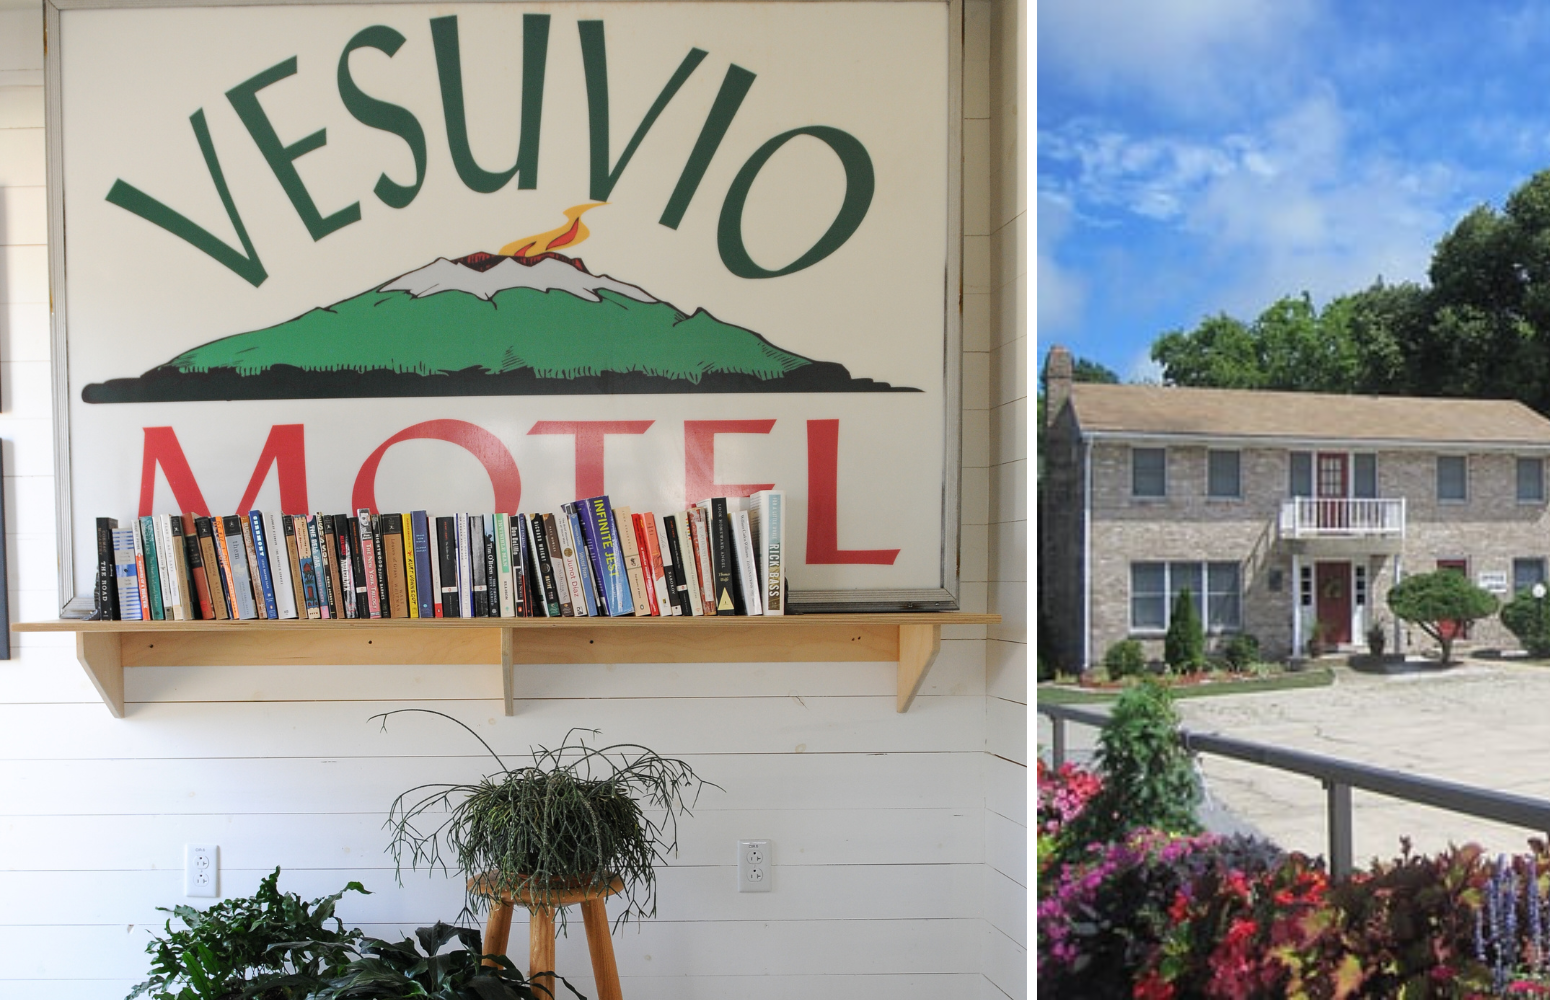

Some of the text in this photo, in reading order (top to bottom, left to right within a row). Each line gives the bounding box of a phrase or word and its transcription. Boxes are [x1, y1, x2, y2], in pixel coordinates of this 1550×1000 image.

[105, 13, 875, 288] VESUVIO
[138, 418, 900, 567] MOTEL
[233, 541, 241, 560] them
[253, 516, 265, 557] CEREMONY
[498, 520, 506, 551] INVISIBLE
[534, 521, 547, 562] RICHARD WRIGHT
[594, 499, 613, 549] INFINITE
[605, 550, 620, 578] JEST
[545, 575, 553, 590] NATIVE
[567, 558, 581, 598] Junot Díaz
[668, 572, 676, 595] NABOKOV
[770, 544, 779, 596] RICK BASS
